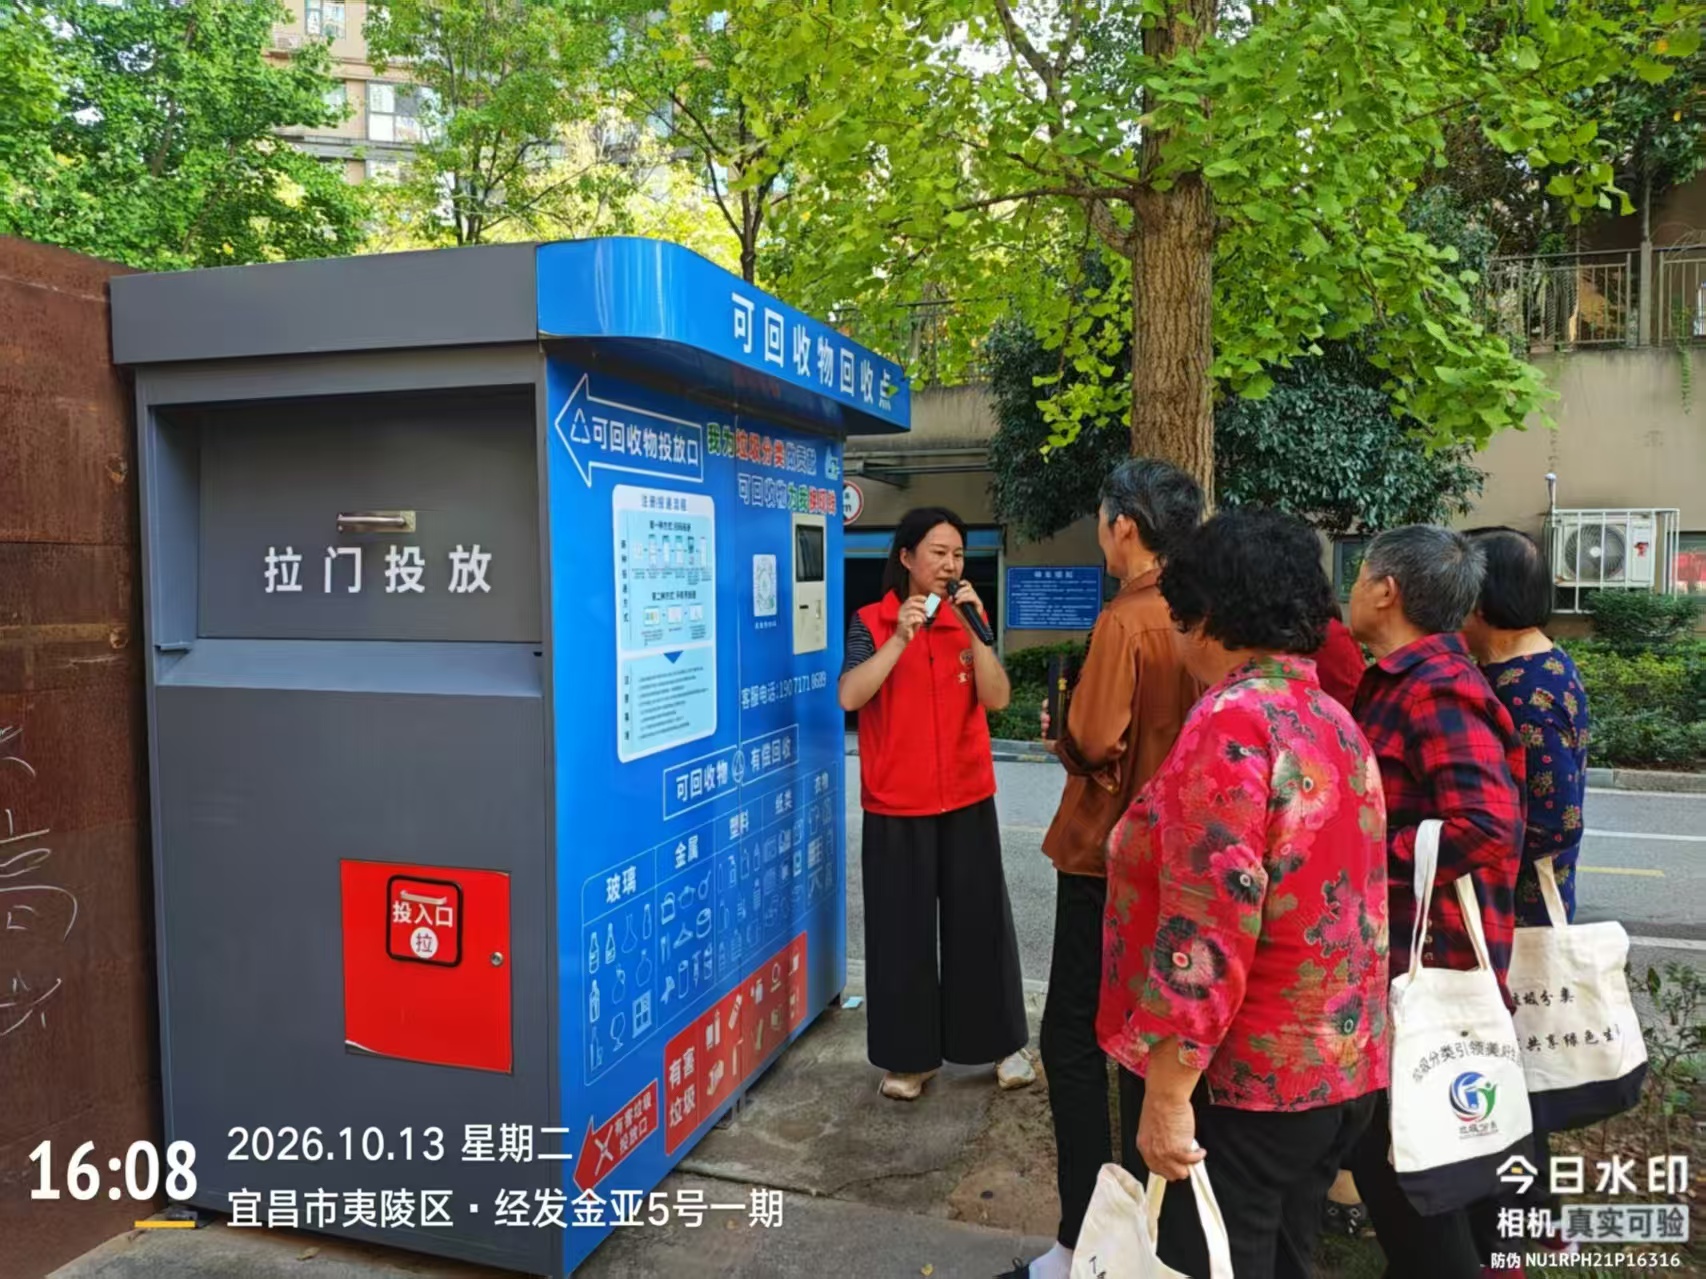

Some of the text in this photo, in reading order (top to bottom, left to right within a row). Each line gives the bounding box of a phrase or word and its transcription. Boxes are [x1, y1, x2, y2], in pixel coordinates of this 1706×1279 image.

[731, 291, 892, 412] 可回收物回收点
[592, 416, 699, 466] 可回收物投放口
[264, 544, 493, 594] 拉门投放
[675, 759, 729, 802] 可回收物
[729, 810, 749, 840] 塑料
[674, 834, 698, 869] 金属
[605, 864, 637, 904] 玻璃
[392, 899, 453, 928] 投入口
[415, 932, 433, 953] 拉
[1517, 1024, 1620, 1053] 共享绿色生
[668, 1046, 695, 1091] 有害
[668, 1084, 696, 1128] 垃圾
